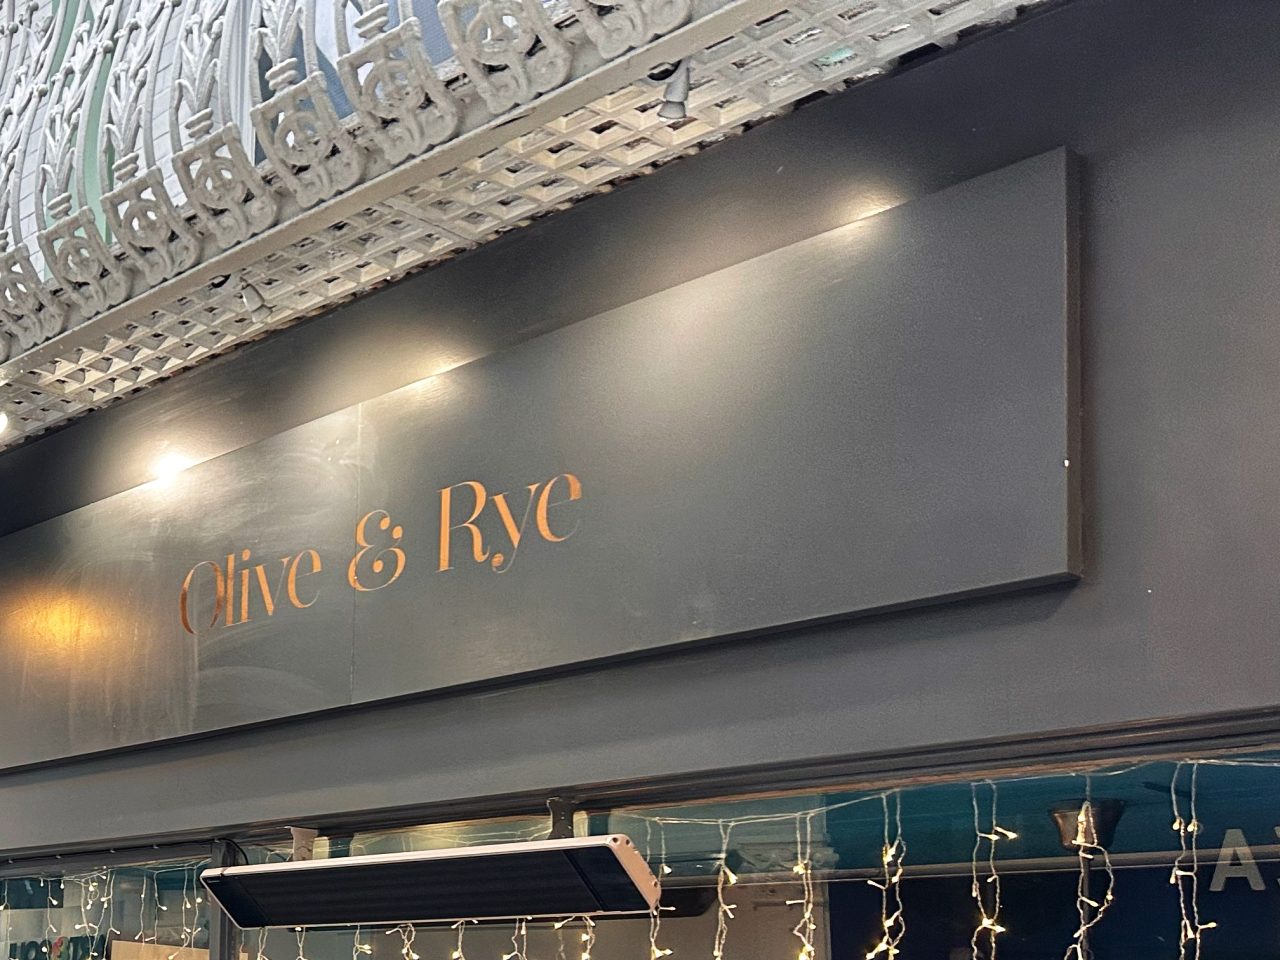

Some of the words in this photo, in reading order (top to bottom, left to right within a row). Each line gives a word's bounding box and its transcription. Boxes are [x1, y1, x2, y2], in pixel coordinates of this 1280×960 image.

[179, 548, 323, 636] Olive
[347, 508, 407, 592] &
[434, 472, 583, 574] Rye
